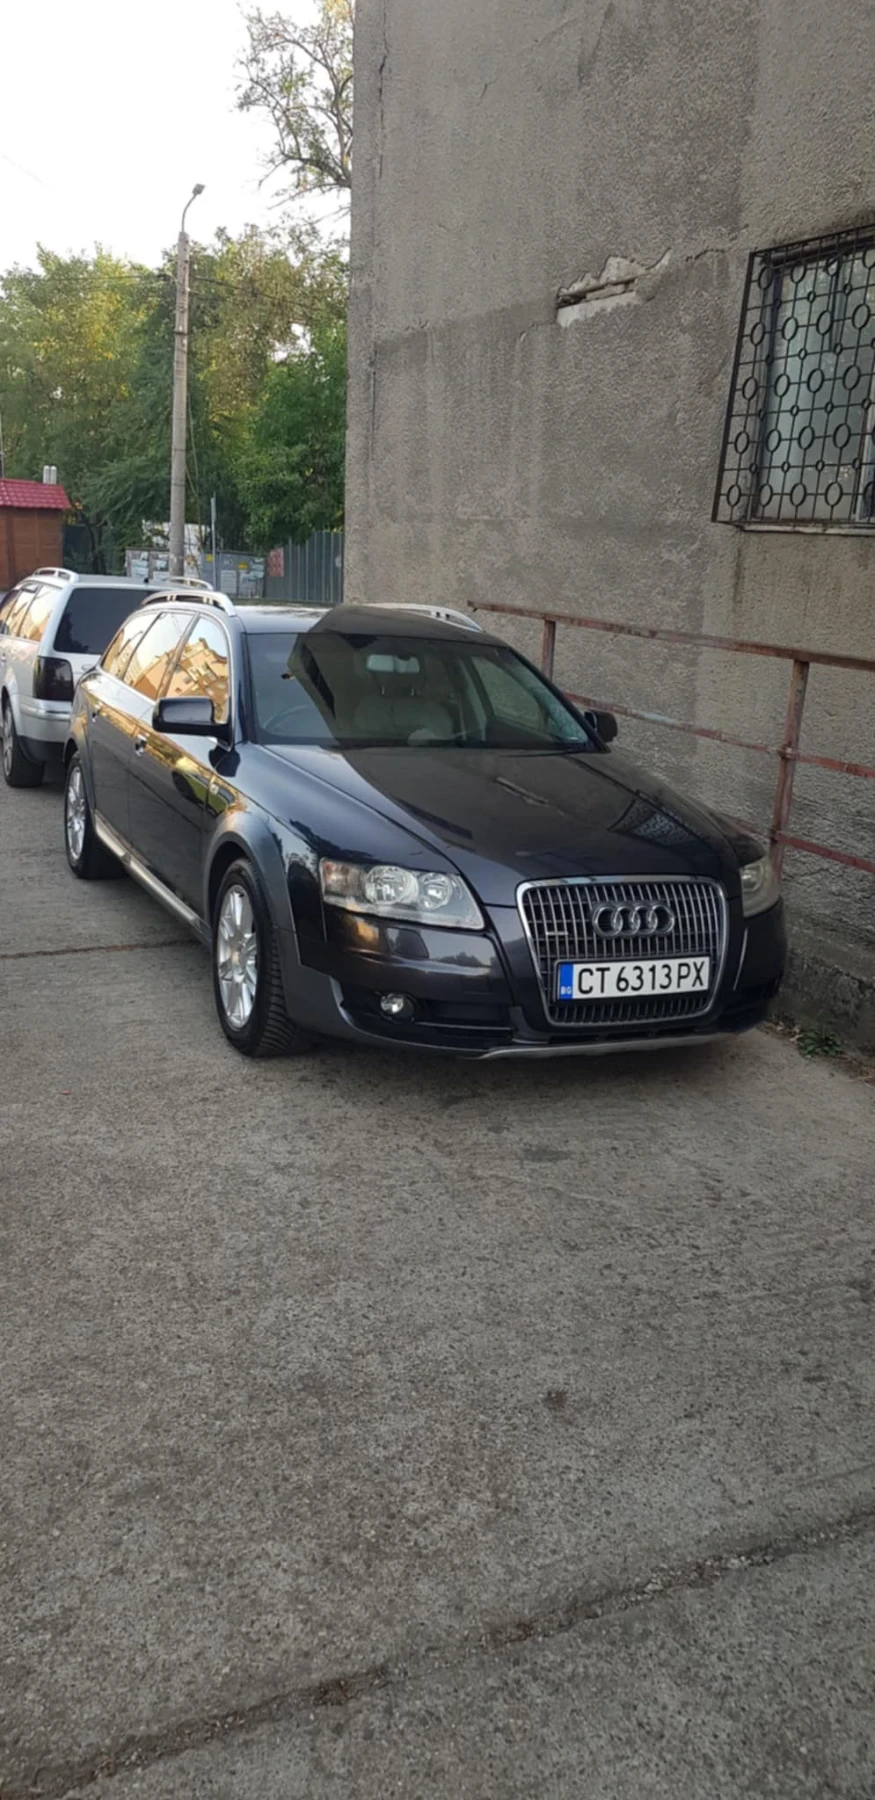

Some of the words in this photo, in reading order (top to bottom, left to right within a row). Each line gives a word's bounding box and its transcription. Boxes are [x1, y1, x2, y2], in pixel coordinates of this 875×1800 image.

[577, 967, 611, 995] CT
[616, 964, 672, 992] 6313
[676, 961, 705, 989] PX
[560, 986, 572, 994] BG
